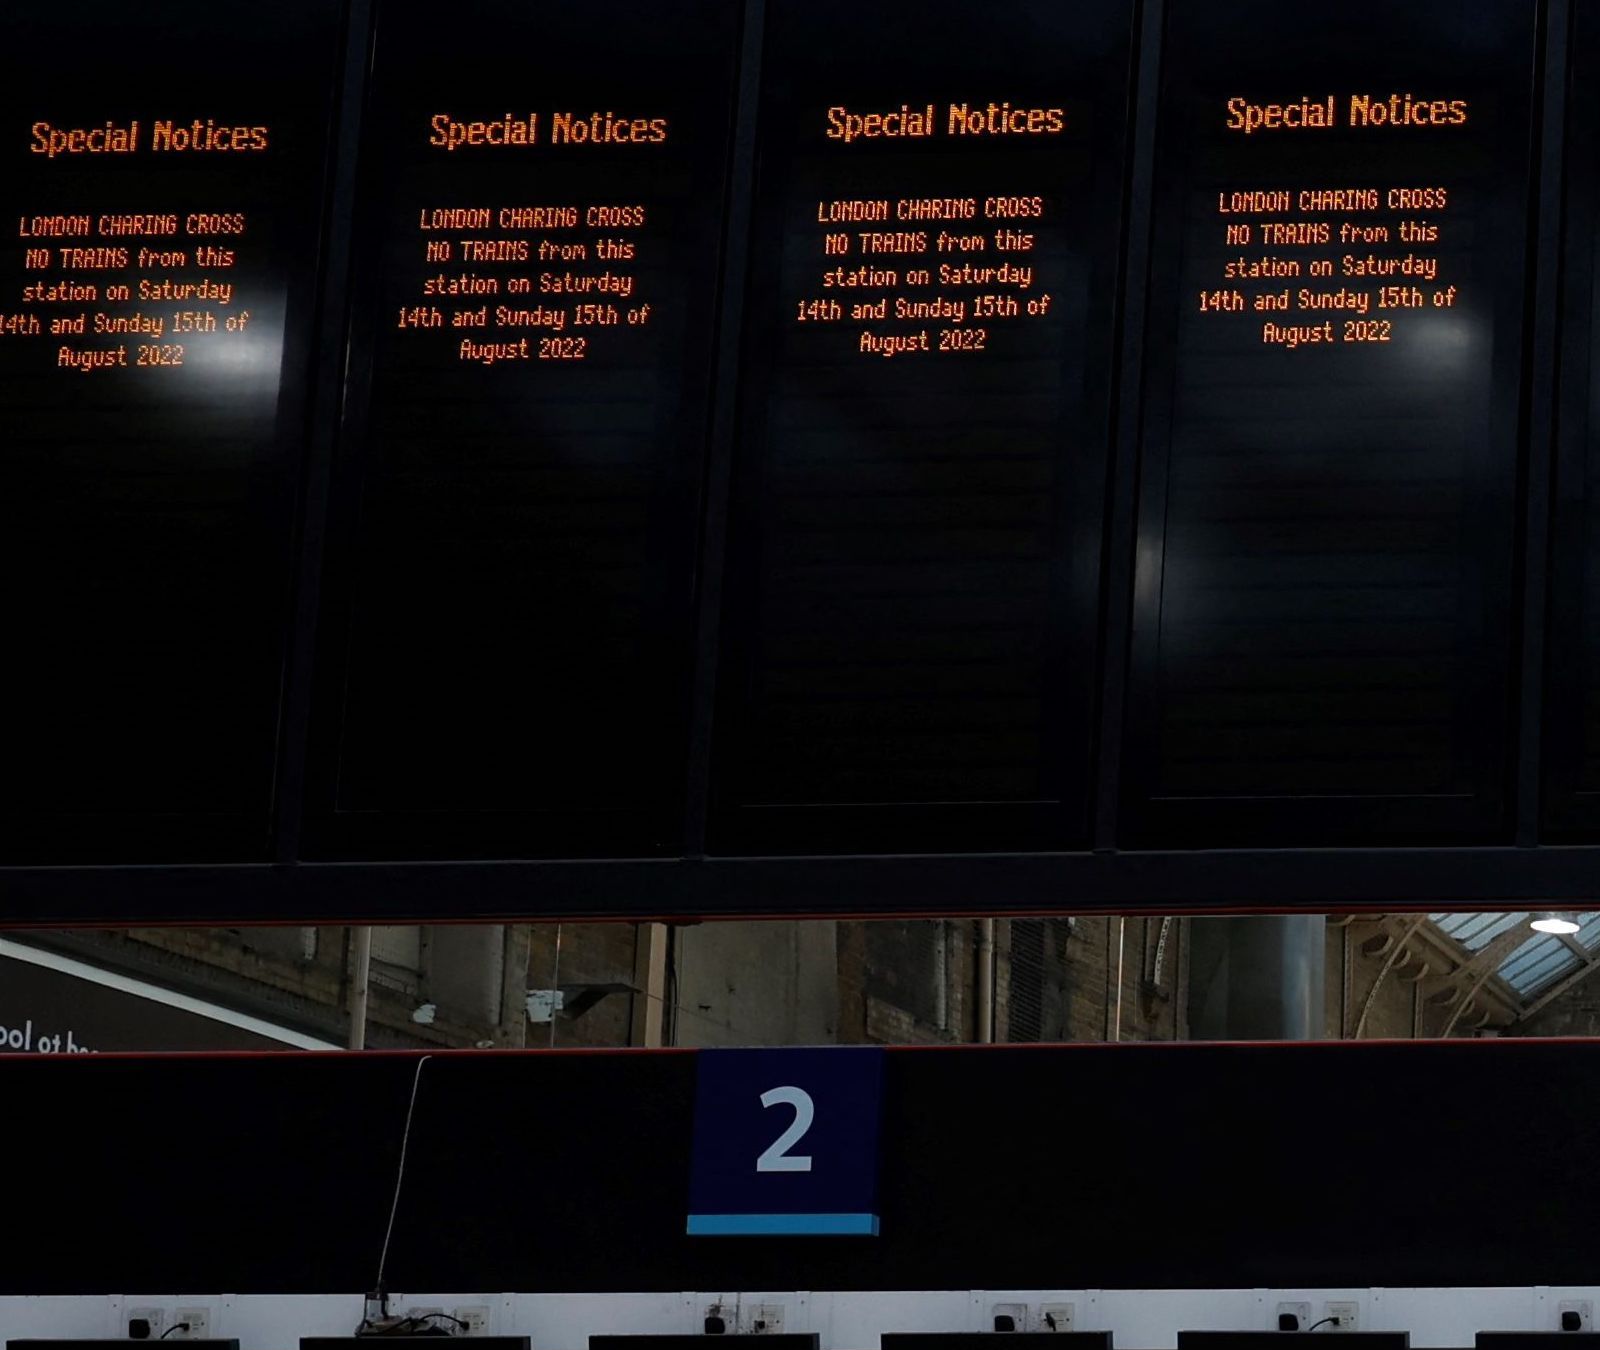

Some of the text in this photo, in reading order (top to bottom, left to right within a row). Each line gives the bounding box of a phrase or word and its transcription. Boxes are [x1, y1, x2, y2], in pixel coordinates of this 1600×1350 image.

[429, 111, 667, 151] Special Notices
[420, 205, 645, 229] LONDON CHARING CROSS
[426, 238, 634, 262] NO TRAINS from this
[423, 271, 632, 297] station on Saturday
[398, 303, 651, 331] 14th and Sunday 15th of
[459, 337, 586, 365] August 2022
[756, 1086, 814, 1172] 2
